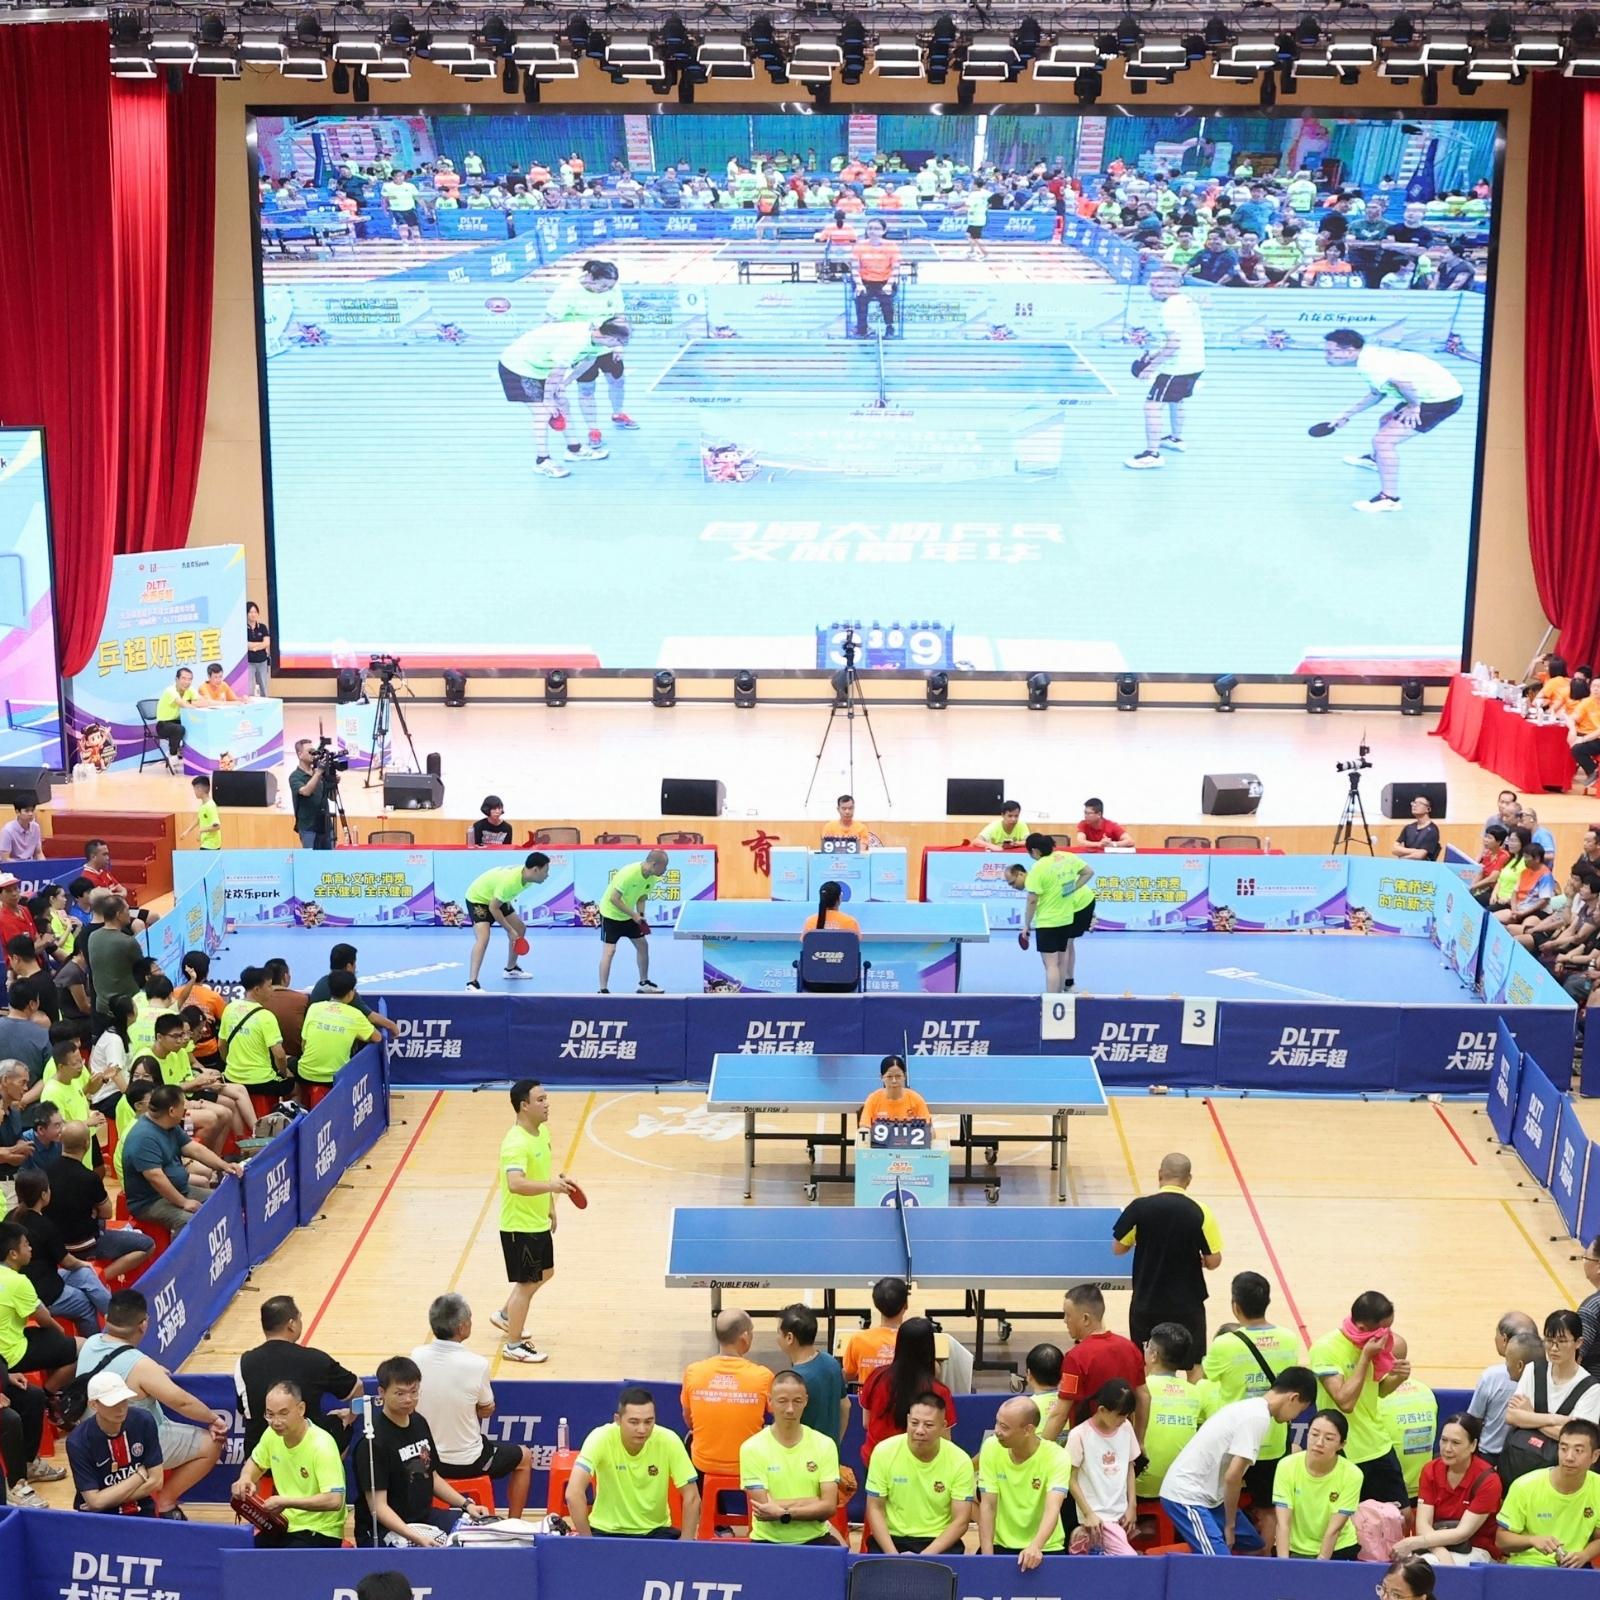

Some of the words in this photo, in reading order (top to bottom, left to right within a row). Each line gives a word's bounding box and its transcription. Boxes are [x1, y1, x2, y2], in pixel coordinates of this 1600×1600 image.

[98, 628, 222, 677] 乒超观察室
[908, 632, 942, 666] 9
[824, 841, 834, 853] 9
[846, 841, 857, 853] 3
[321, 872, 407, 885] 体育+文旅+消费
[1096, 876, 1182, 890] 体育+文旅+消费
[314, 885, 361, 899] 全民健身
[365, 885, 414, 899] 全民健康
[1139, 889, 1188, 904] 全民健康
[760, 979, 782, 988] 2026
[231, 985, 244, 1001] 3
[1052, 1002, 1065, 1021] 0
[1193, 1009, 1206, 1028] 3
[1281, 1028, 1340, 1046] DLTT
[1269, 1047, 1347, 1068] 大沥乒超
[859, 1131, 869, 1142] T
[874, 1125, 888, 1142] 9
[911, 1128, 925, 1145] 2
[267, 1158, 286, 1194] DLTT
[209, 1216, 226, 1256] DLTT
[710, 1280, 742, 1289] DOUBLE
[743, 1280, 760, 1289] FISH
[154, 1278, 176, 1321] DLTT
[1155, 1414, 1193, 1426] 河西社区
[1396, 1411, 1433, 1424] 河西社区
[73, 1552, 162, 1585] DLTT
